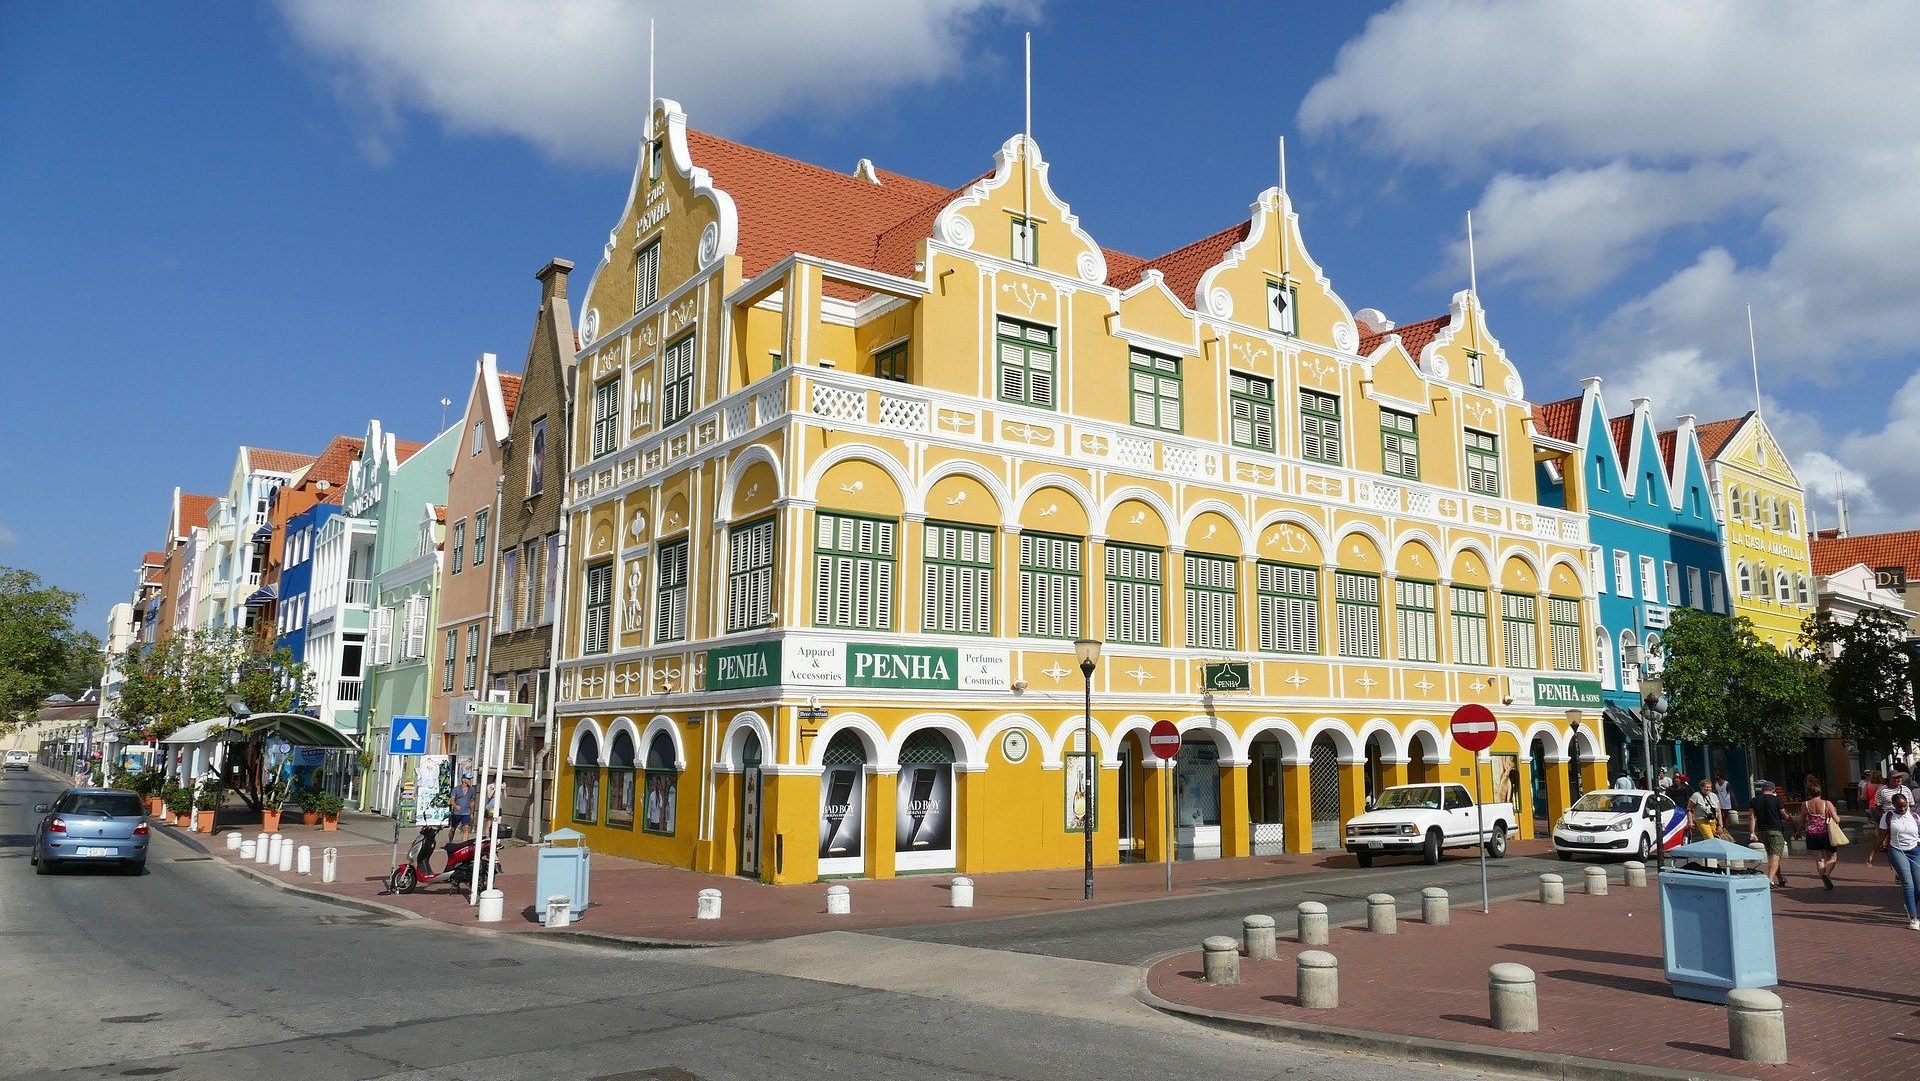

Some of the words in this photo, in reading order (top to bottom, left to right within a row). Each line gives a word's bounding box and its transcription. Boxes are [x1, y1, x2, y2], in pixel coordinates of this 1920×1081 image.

[636, 198, 670, 238] PENHA
[1731, 530, 1743, 546] LA
[1744, 534, 1765, 552] CASA
[1767, 542, 1805, 562] AMARILLA
[797, 646, 836, 658] Apparel
[811, 659, 821, 668] &
[965, 653, 1004, 664] Perfumes
[717, 652, 768, 681] PENHA
[854, 652, 950, 681] PENHA
[980, 665, 988, 674] &
[788, 670, 843, 681] Accessories
[964, 675, 1005, 686] Cosmetics
[1537, 683, 1580, 701] PENHA
[1581, 694, 1586, 702] &
[1586, 694, 1600, 703] SONS
